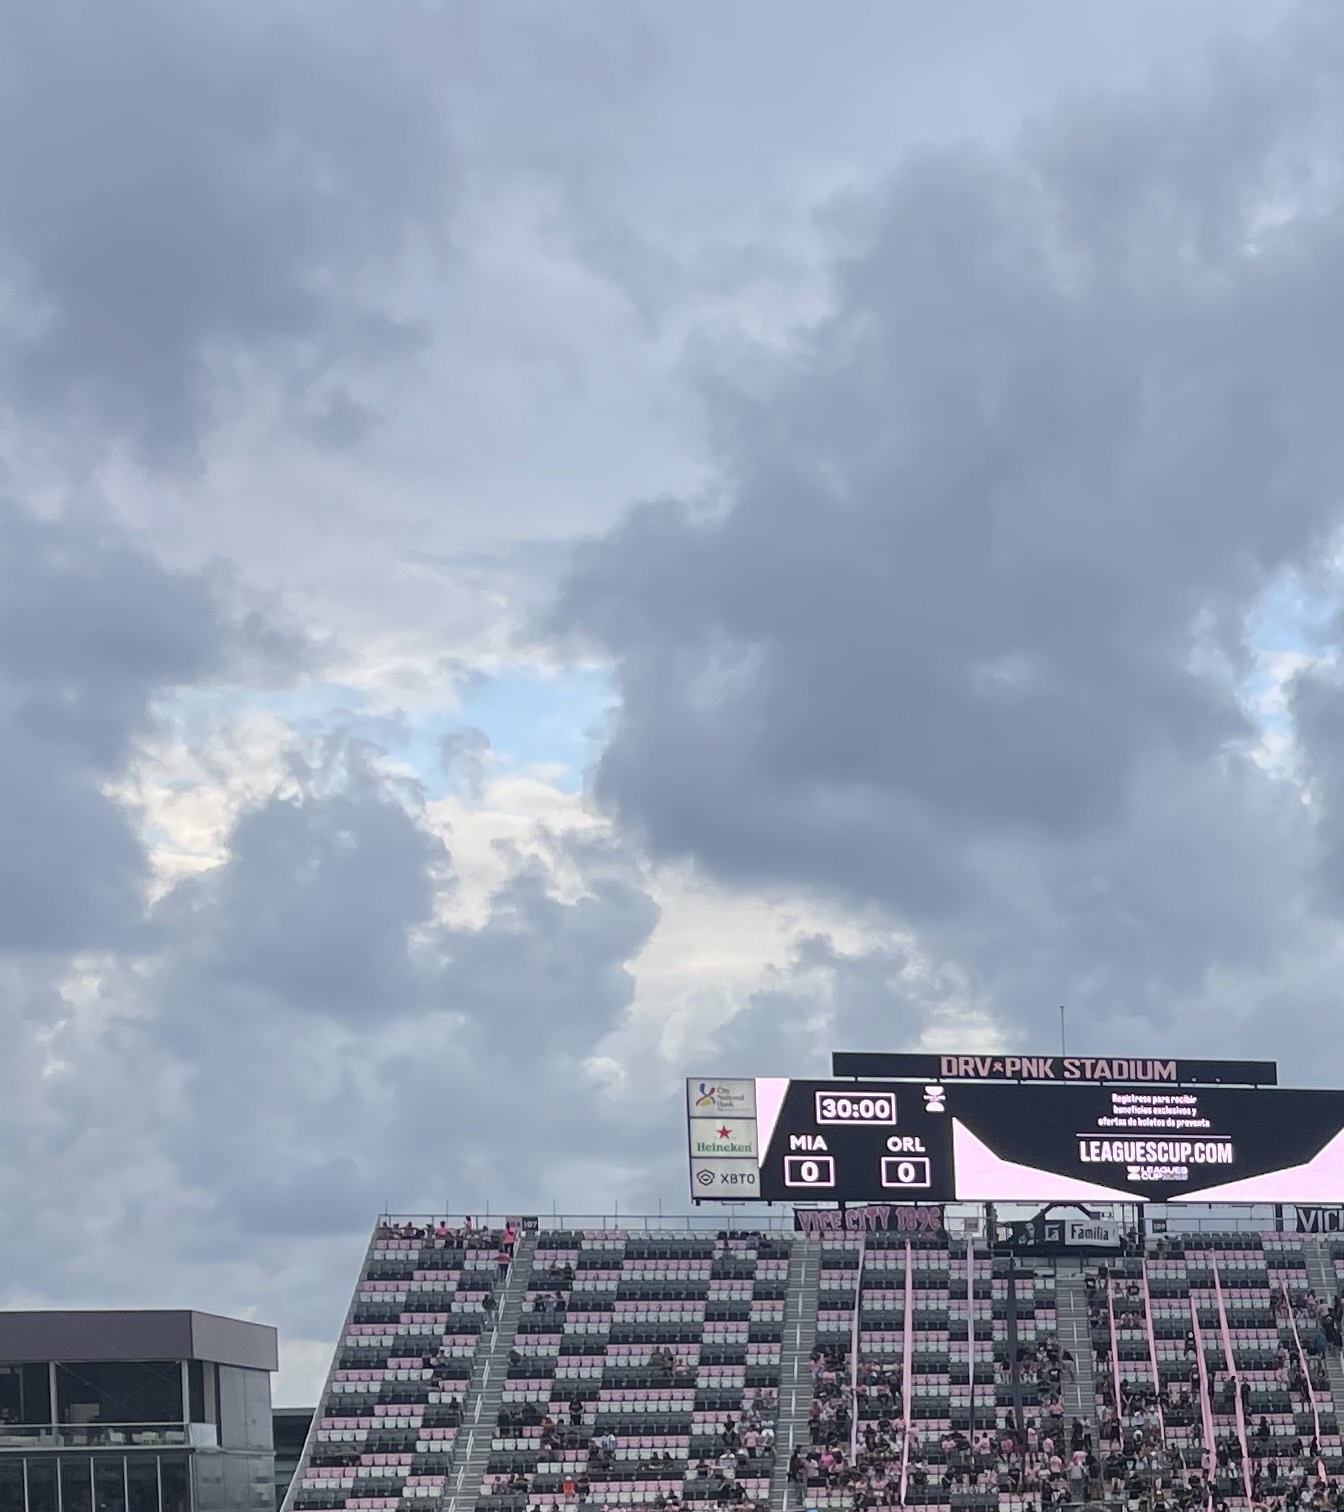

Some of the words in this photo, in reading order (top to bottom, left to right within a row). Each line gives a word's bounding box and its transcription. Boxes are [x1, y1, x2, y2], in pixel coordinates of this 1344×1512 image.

[1063, 1058, 1177, 1082] STADIUM
[822, 1099, 890, 1119] 30:00
[696, 1142, 753, 1153] Heineken
[789, 1134, 828, 1151] MIA
[886, 1136, 926, 1152] ORL
[1079, 1140, 1233, 1164] LEAGUESCUP.COM
[720, 1173, 756, 1185] XBTO
[800, 1161, 819, 1183] 0
[897, 1162, 917, 1183] 0
[798, 1210, 843, 1234] VICE
[845, 1206, 890, 1232] CITY
[1070, 1223, 1110, 1241] Familia
